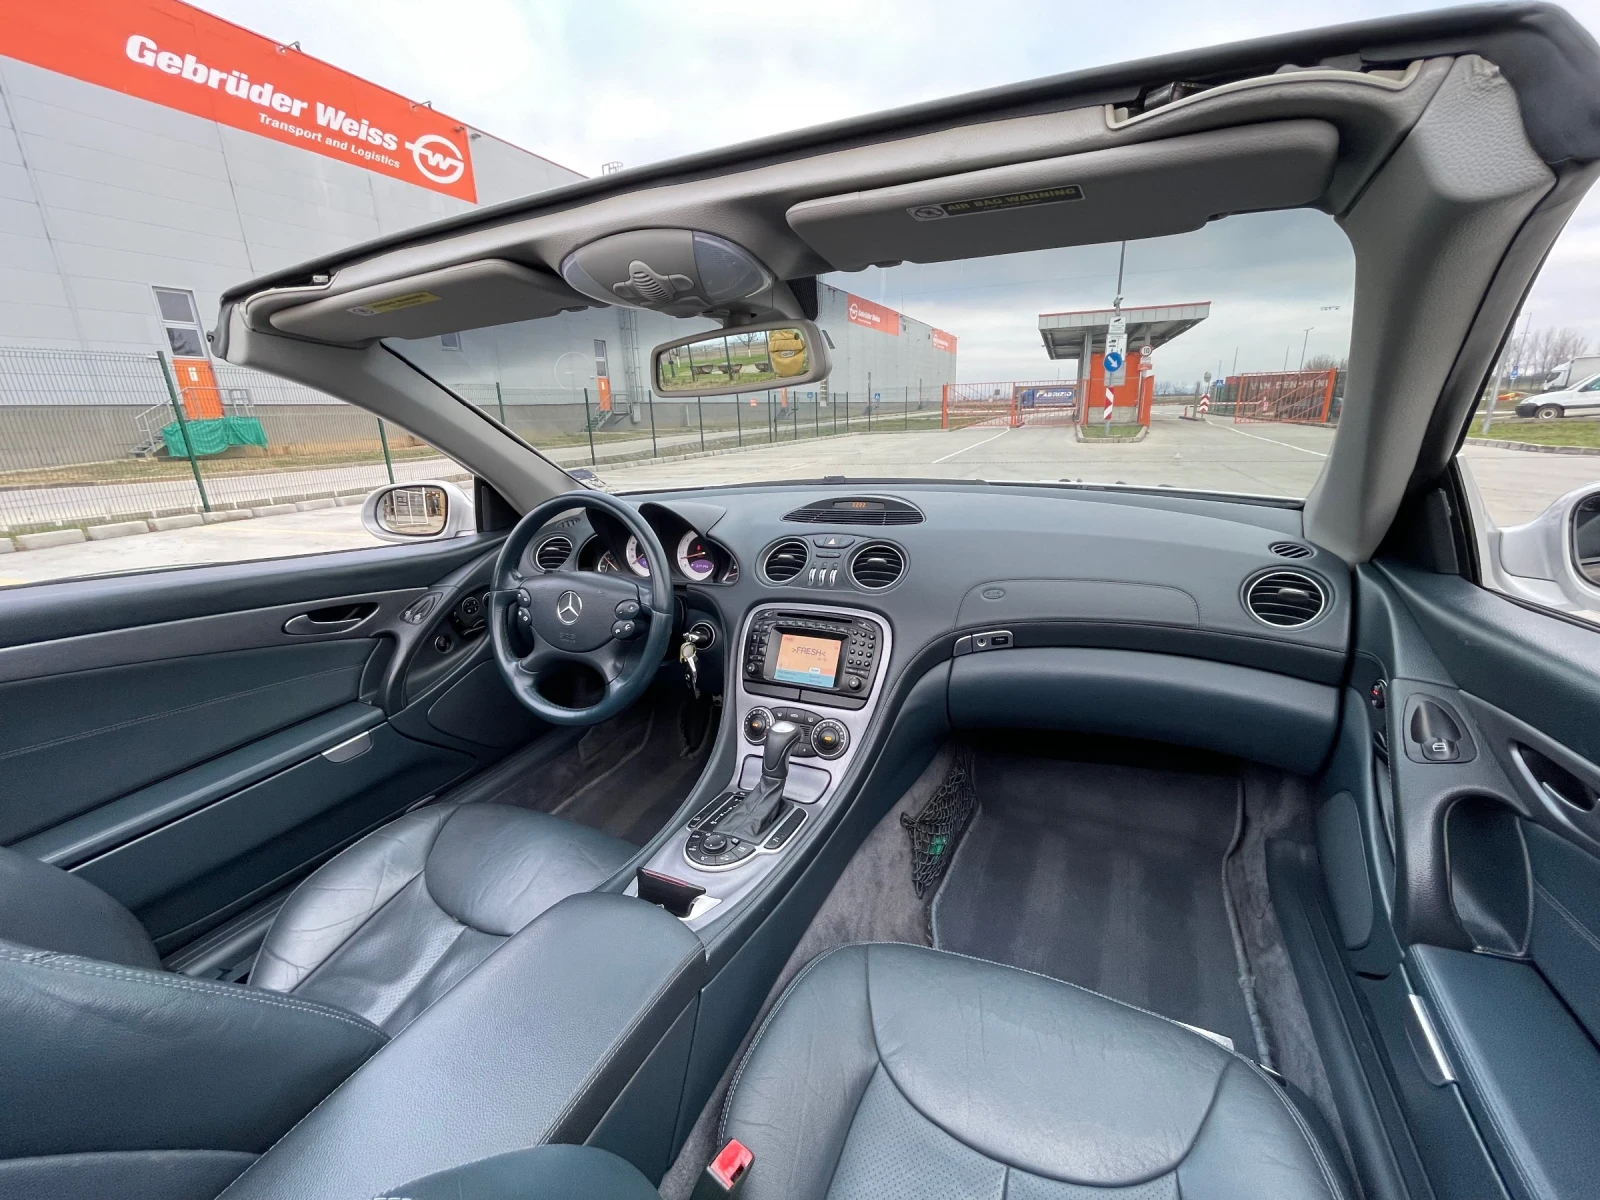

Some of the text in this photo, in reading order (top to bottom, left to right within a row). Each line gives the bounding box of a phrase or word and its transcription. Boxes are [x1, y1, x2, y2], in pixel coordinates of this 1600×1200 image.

[125, 34, 398, 151] Gebrüder Weiss
[258, 113, 400, 169] Transport and Logistics
[947, 203, 970, 211] AIR
[973, 198, 1002, 207] BAG
[1005, 188, 1076, 203] WARNING
